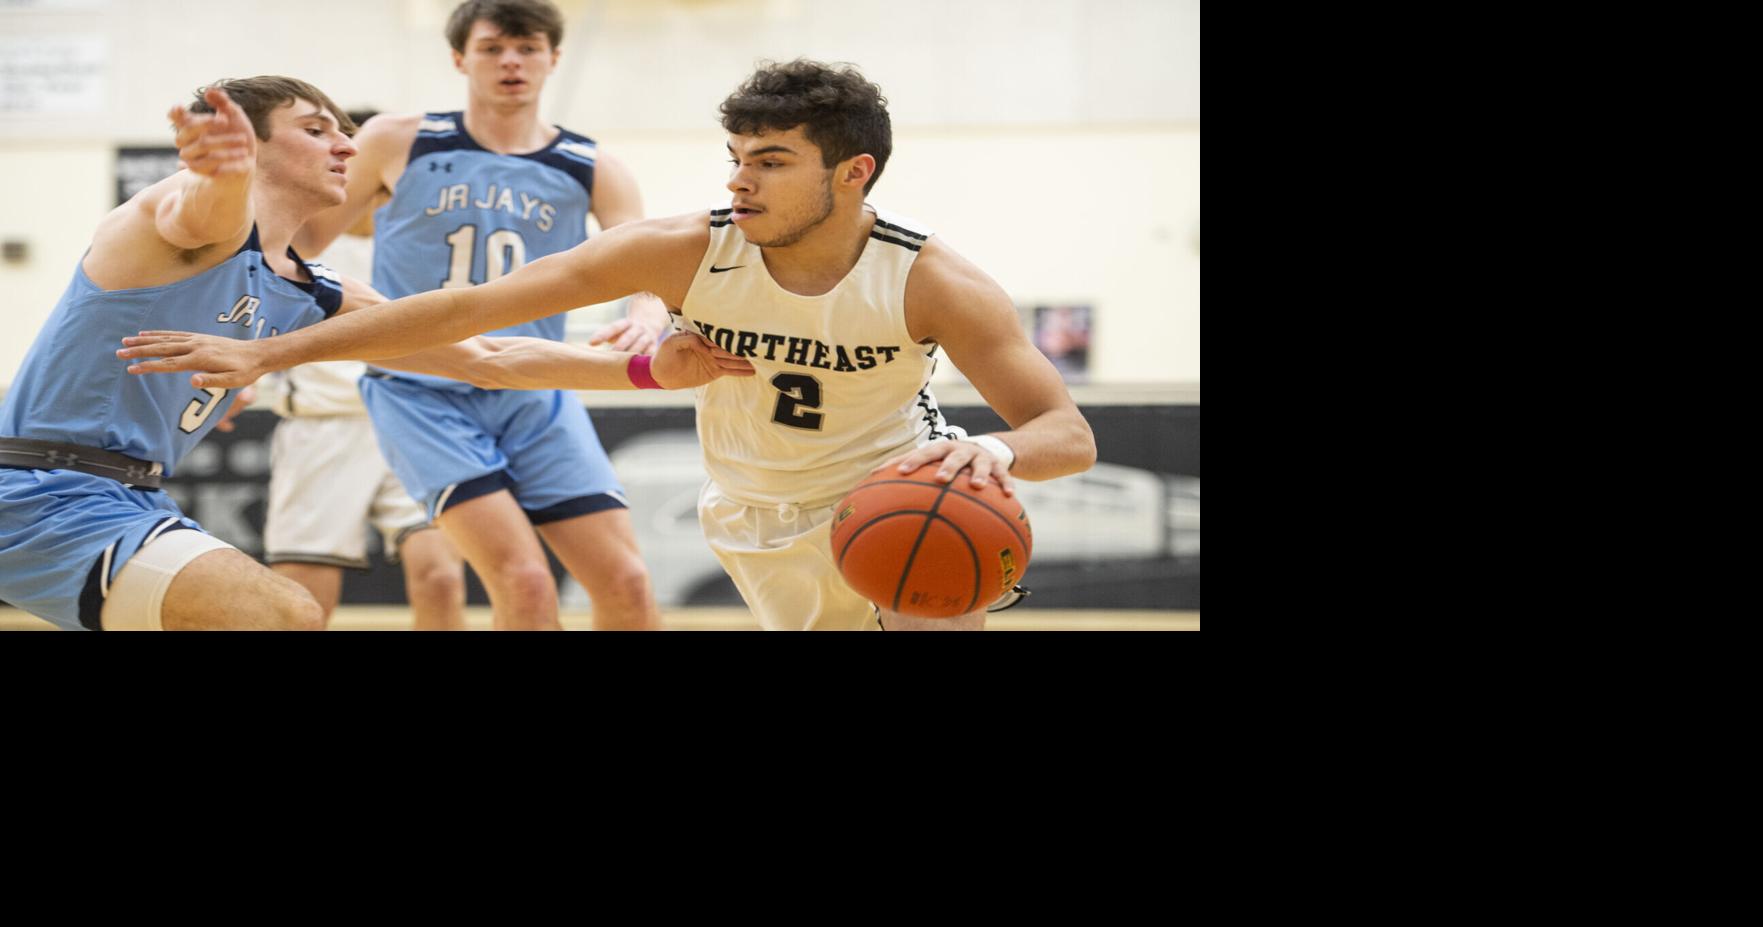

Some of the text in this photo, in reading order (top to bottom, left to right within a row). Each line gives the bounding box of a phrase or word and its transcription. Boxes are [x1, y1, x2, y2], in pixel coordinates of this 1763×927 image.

[425, 183, 557, 233] JR JAYS
[440, 223, 526, 290] 10
[216, 294, 261, 328] JR
[693, 319, 900, 372] NORTHEAST
[769, 370, 825, 432] 2
